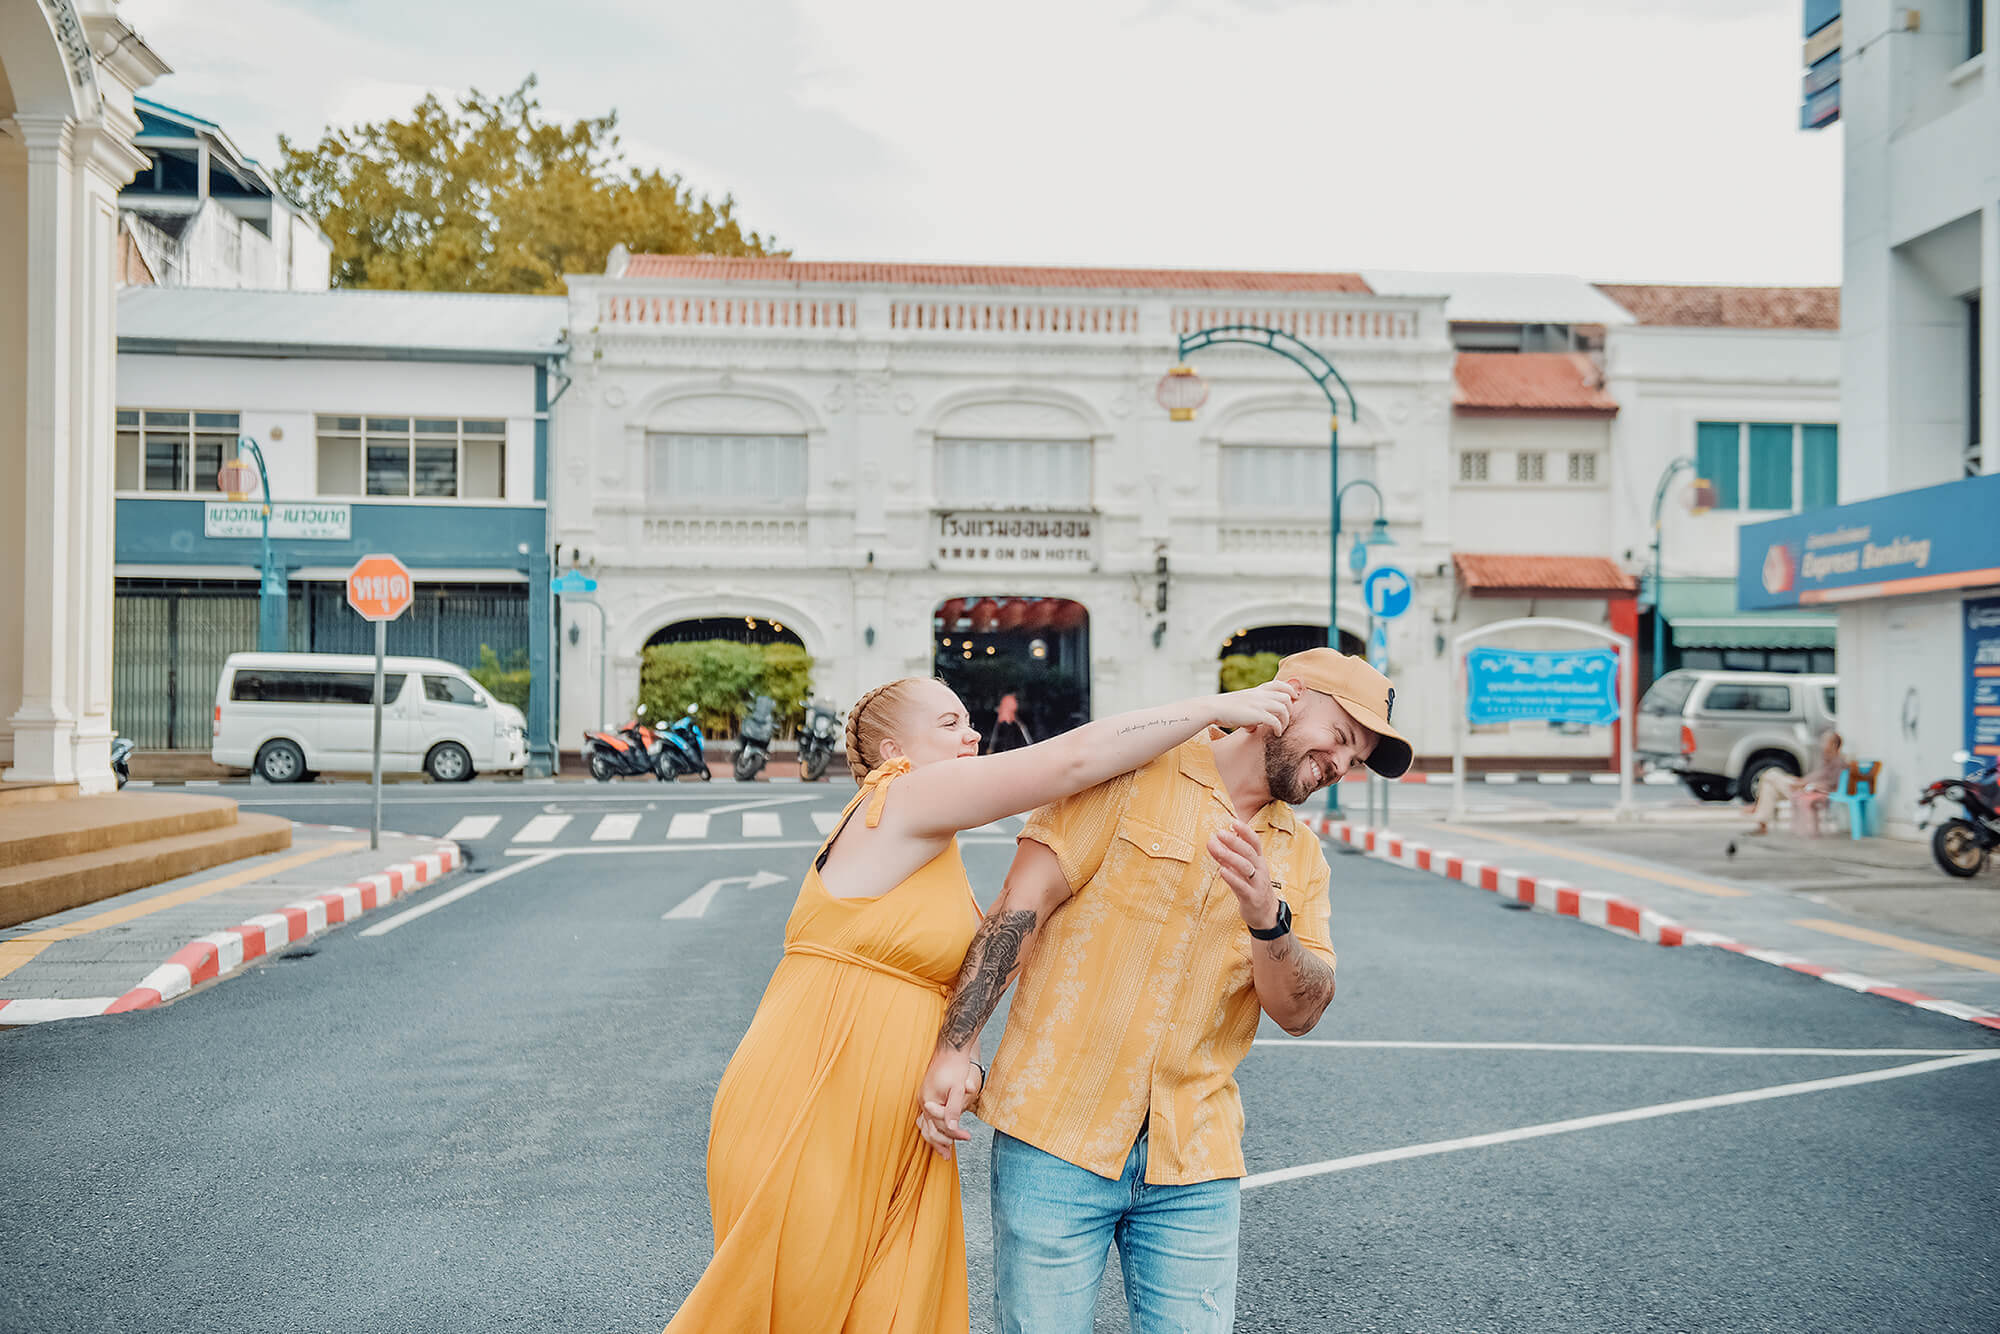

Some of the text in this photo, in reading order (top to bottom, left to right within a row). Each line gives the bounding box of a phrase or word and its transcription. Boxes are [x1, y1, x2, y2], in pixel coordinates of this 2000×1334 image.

[995, 548, 1015, 560] ON
[1020, 548, 1040, 560] ON
[1045, 549, 1090, 561] HOTEL
[1861, 537, 1930, 570] Banking
[353, 575, 406, 612] หยุด
